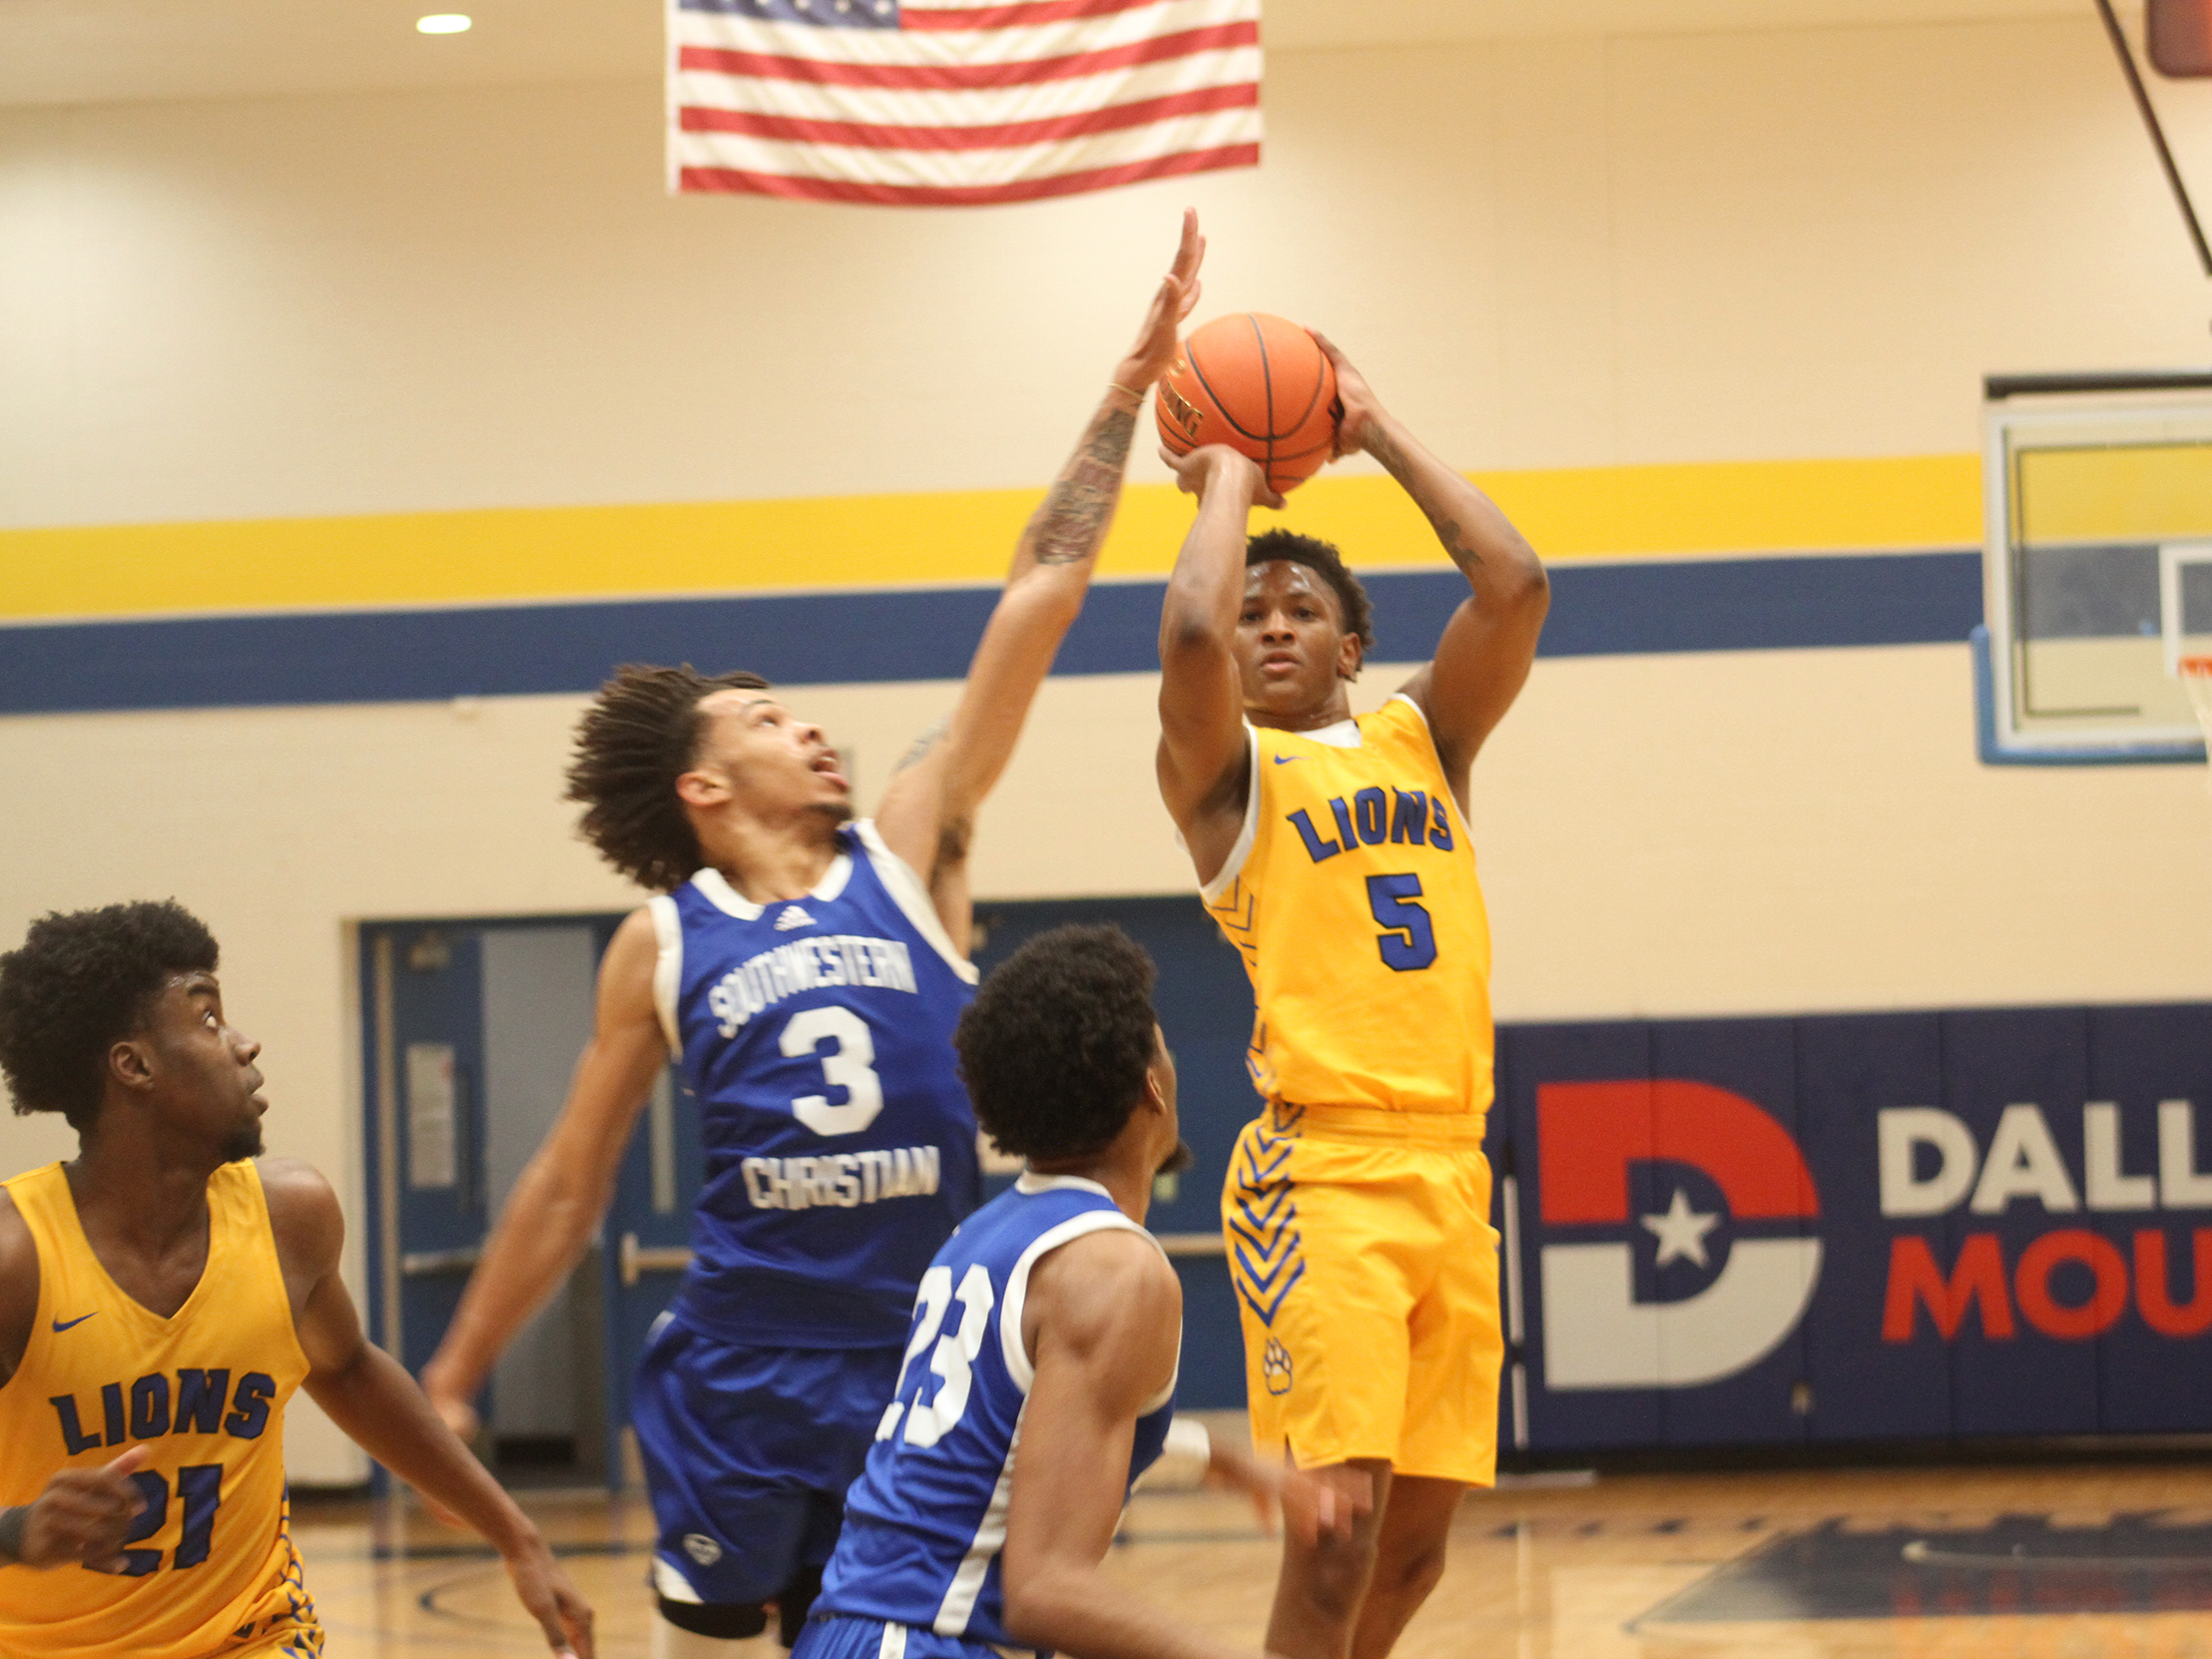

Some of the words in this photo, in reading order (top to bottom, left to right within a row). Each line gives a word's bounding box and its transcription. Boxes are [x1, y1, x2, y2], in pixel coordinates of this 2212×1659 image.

[1286, 786, 1454, 863] LIONS
[1365, 872, 1438, 972] 5
[708, 934, 917, 1039] SOUTHWESTERN
[779, 1005, 883, 1136] 3
[741, 1145, 940, 1210] CHRISTIAN
[1877, 1099, 2212, 1218] DALL
[1881, 1228, 2212, 1345] MOU
[874, 1263, 994, 1449] 23
[48, 1368, 276, 1456] LIONS
